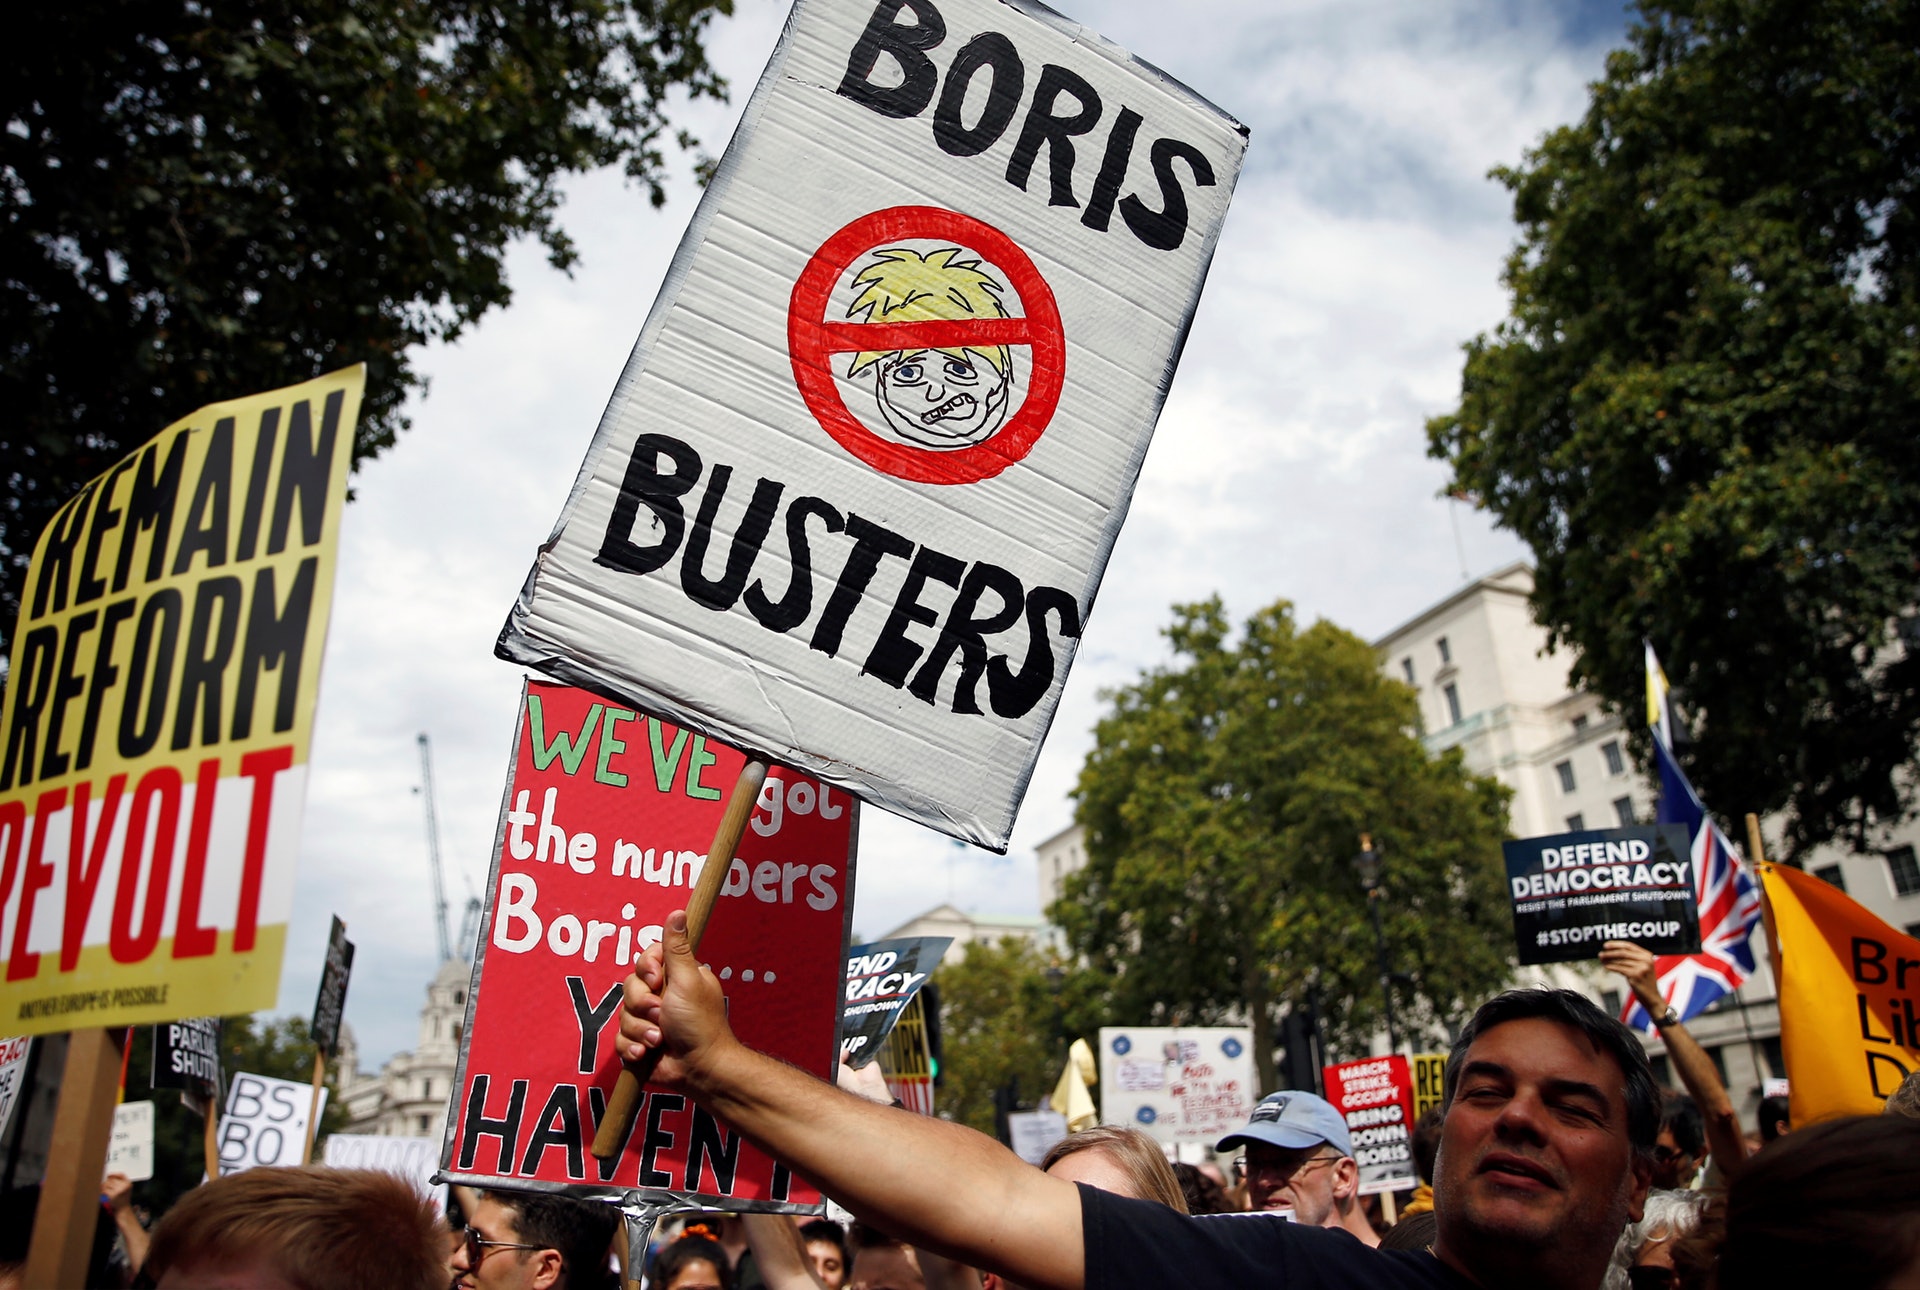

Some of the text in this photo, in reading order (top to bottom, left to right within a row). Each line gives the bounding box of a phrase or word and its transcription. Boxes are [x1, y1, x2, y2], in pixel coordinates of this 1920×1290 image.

[837, 0, 1217, 251] BORIS
[30, 389, 346, 622] REMAIN
[593, 433, 1082, 719] BUSTERS
[0, 556, 318, 792] REFORM
[528, 695, 721, 801] WE'VE
[507, 787, 597, 874] the
[1541, 839, 1650, 871] DEFEND
[1511, 861, 1690, 899] DEMOCRACY
[1515, 890, 1691, 914] RESIST THE PARLIAMENT SHUTDOWN
[1536, 920, 1681, 947] #STOPTHECOUP
[844, 1000, 903, 1017] SHUTDOWN
[1416, 1059, 1445, 1096] RE
[1341, 1085, 1400, 1109] OCCUPY
[1345, 1104, 1404, 1130] BRING
[1351, 1123, 1408, 1147] DOWN
[1355, 1144, 1410, 1167] BORIS
